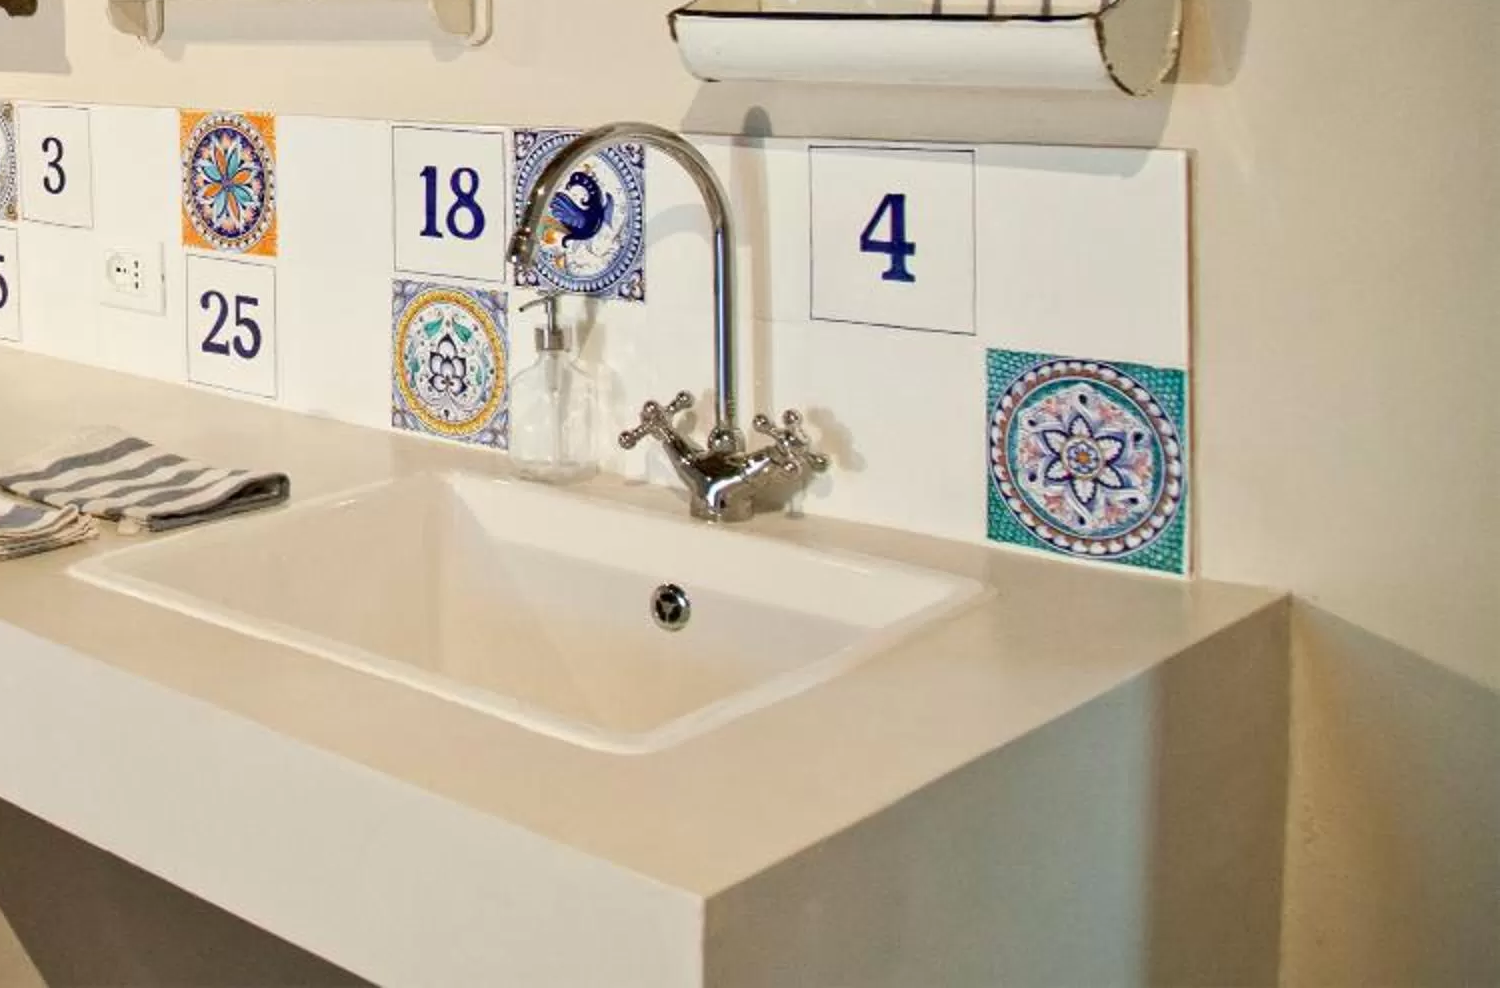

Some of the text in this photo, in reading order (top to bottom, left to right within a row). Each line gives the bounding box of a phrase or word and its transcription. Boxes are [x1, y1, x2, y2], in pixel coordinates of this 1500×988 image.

[41, 136, 66, 195] 3
[419, 165, 486, 241] 18
[859, 192, 917, 283] 4
[199, 290, 262, 360] 25
